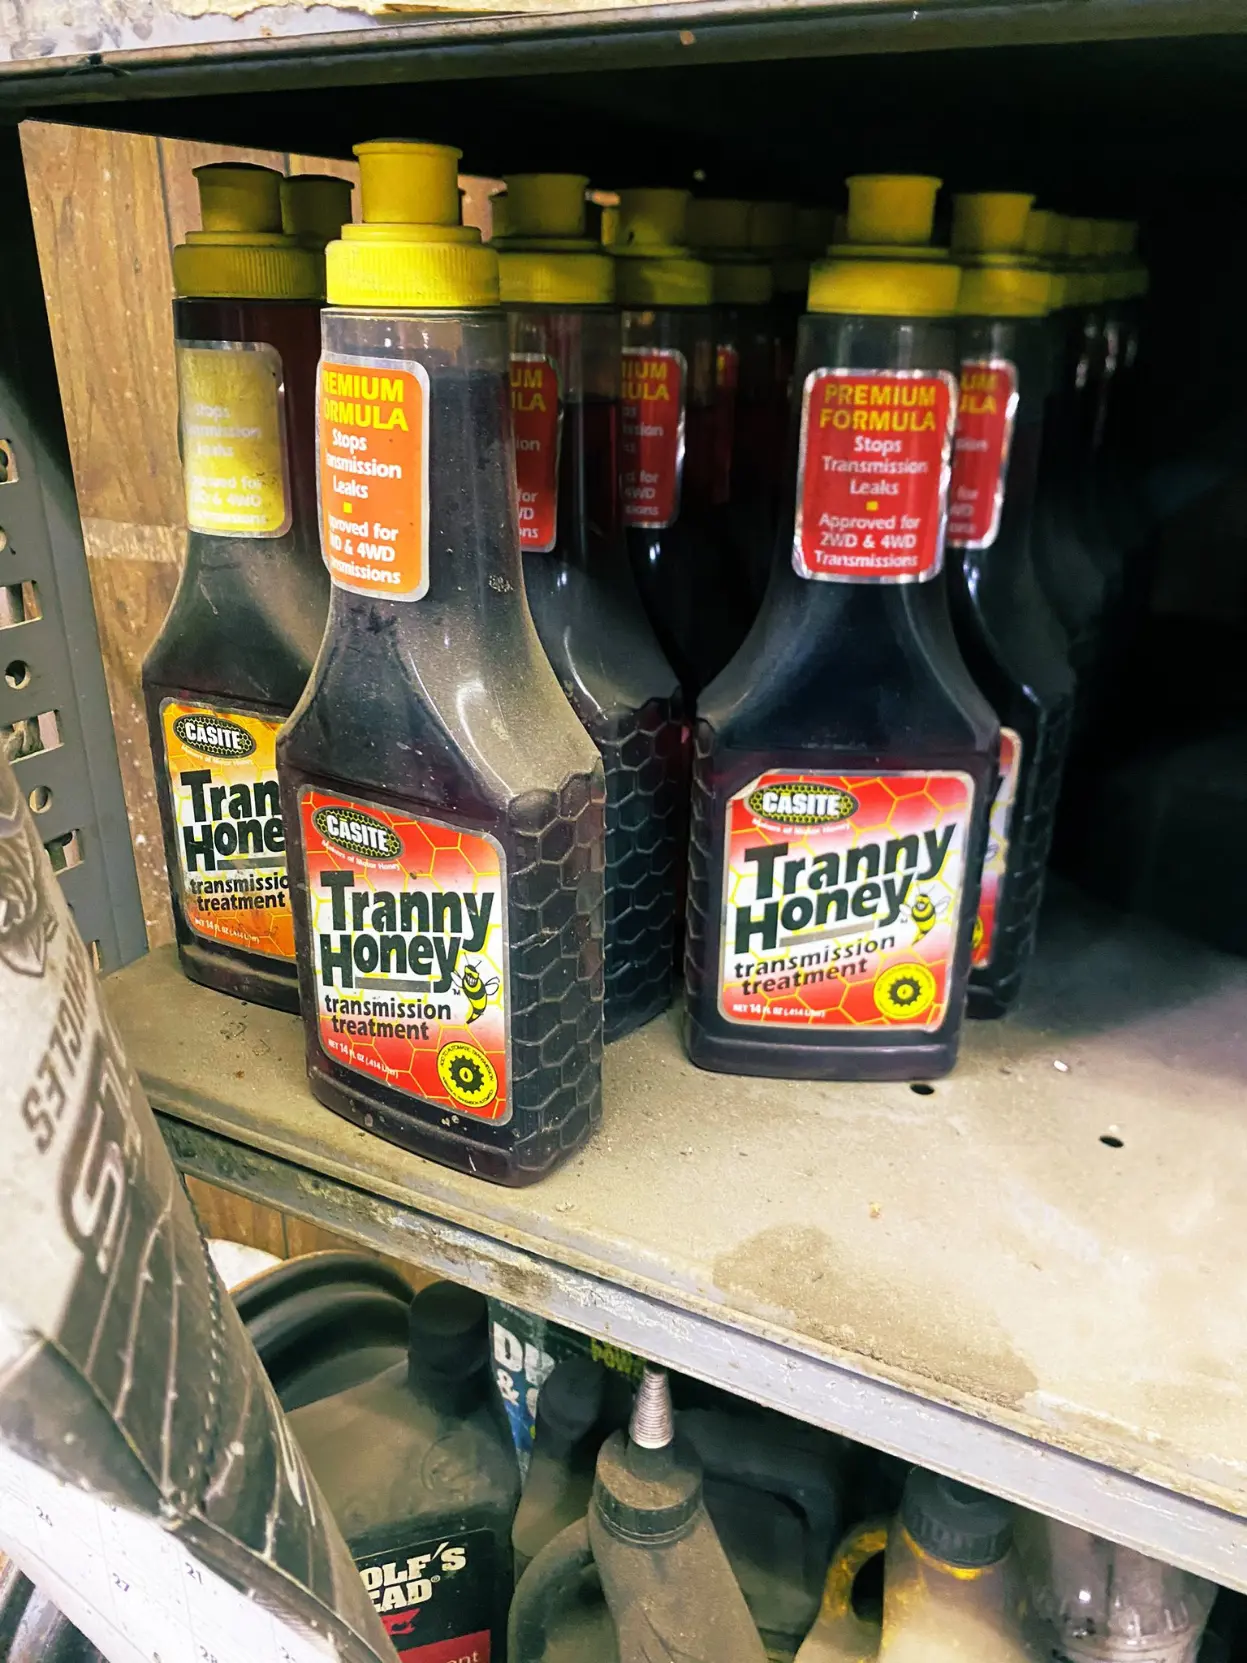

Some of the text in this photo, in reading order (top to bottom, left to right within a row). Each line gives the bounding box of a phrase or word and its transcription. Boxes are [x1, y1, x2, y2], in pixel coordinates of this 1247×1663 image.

[824, 384, 936, 407] PREMIUM
[819, 408, 936, 431] FORMULA
[332, 428, 368, 454] Stops
[854, 436, 902, 456] Stops
[822, 456, 928, 474] Transmission
[333, 474, 368, 499] Leaks
[850, 479, 899, 495] Leaks
[373, 522, 399, 541] for
[818, 513, 920, 530] Approved for
[357, 542, 396, 563] 4WD
[820, 532, 917, 549] 2WD & 4WD
[814, 550, 918, 568] Transmissions
[185, 722, 241, 749] CASITE
[180, 769, 280, 823] Tran
[762, 792, 841, 817] CASITE
[183, 817, 285, 872] Hone
[326, 814, 388, 853] CASITE
[744, 823, 957, 900] Tranny
[197, 892, 286, 912] treatment
[320, 871, 494, 952] Tranny
[734, 872, 915, 954] Honey
[319, 934, 461, 993] Honey
[734, 935, 895, 978] transmission
[741, 957, 868, 996] treatment
[325, 995, 451, 1020] transmission
[331, 1016, 429, 1040] treatment
[340, 1043, 348, 1055] 14
[112, 1572, 130, 1592] 27
